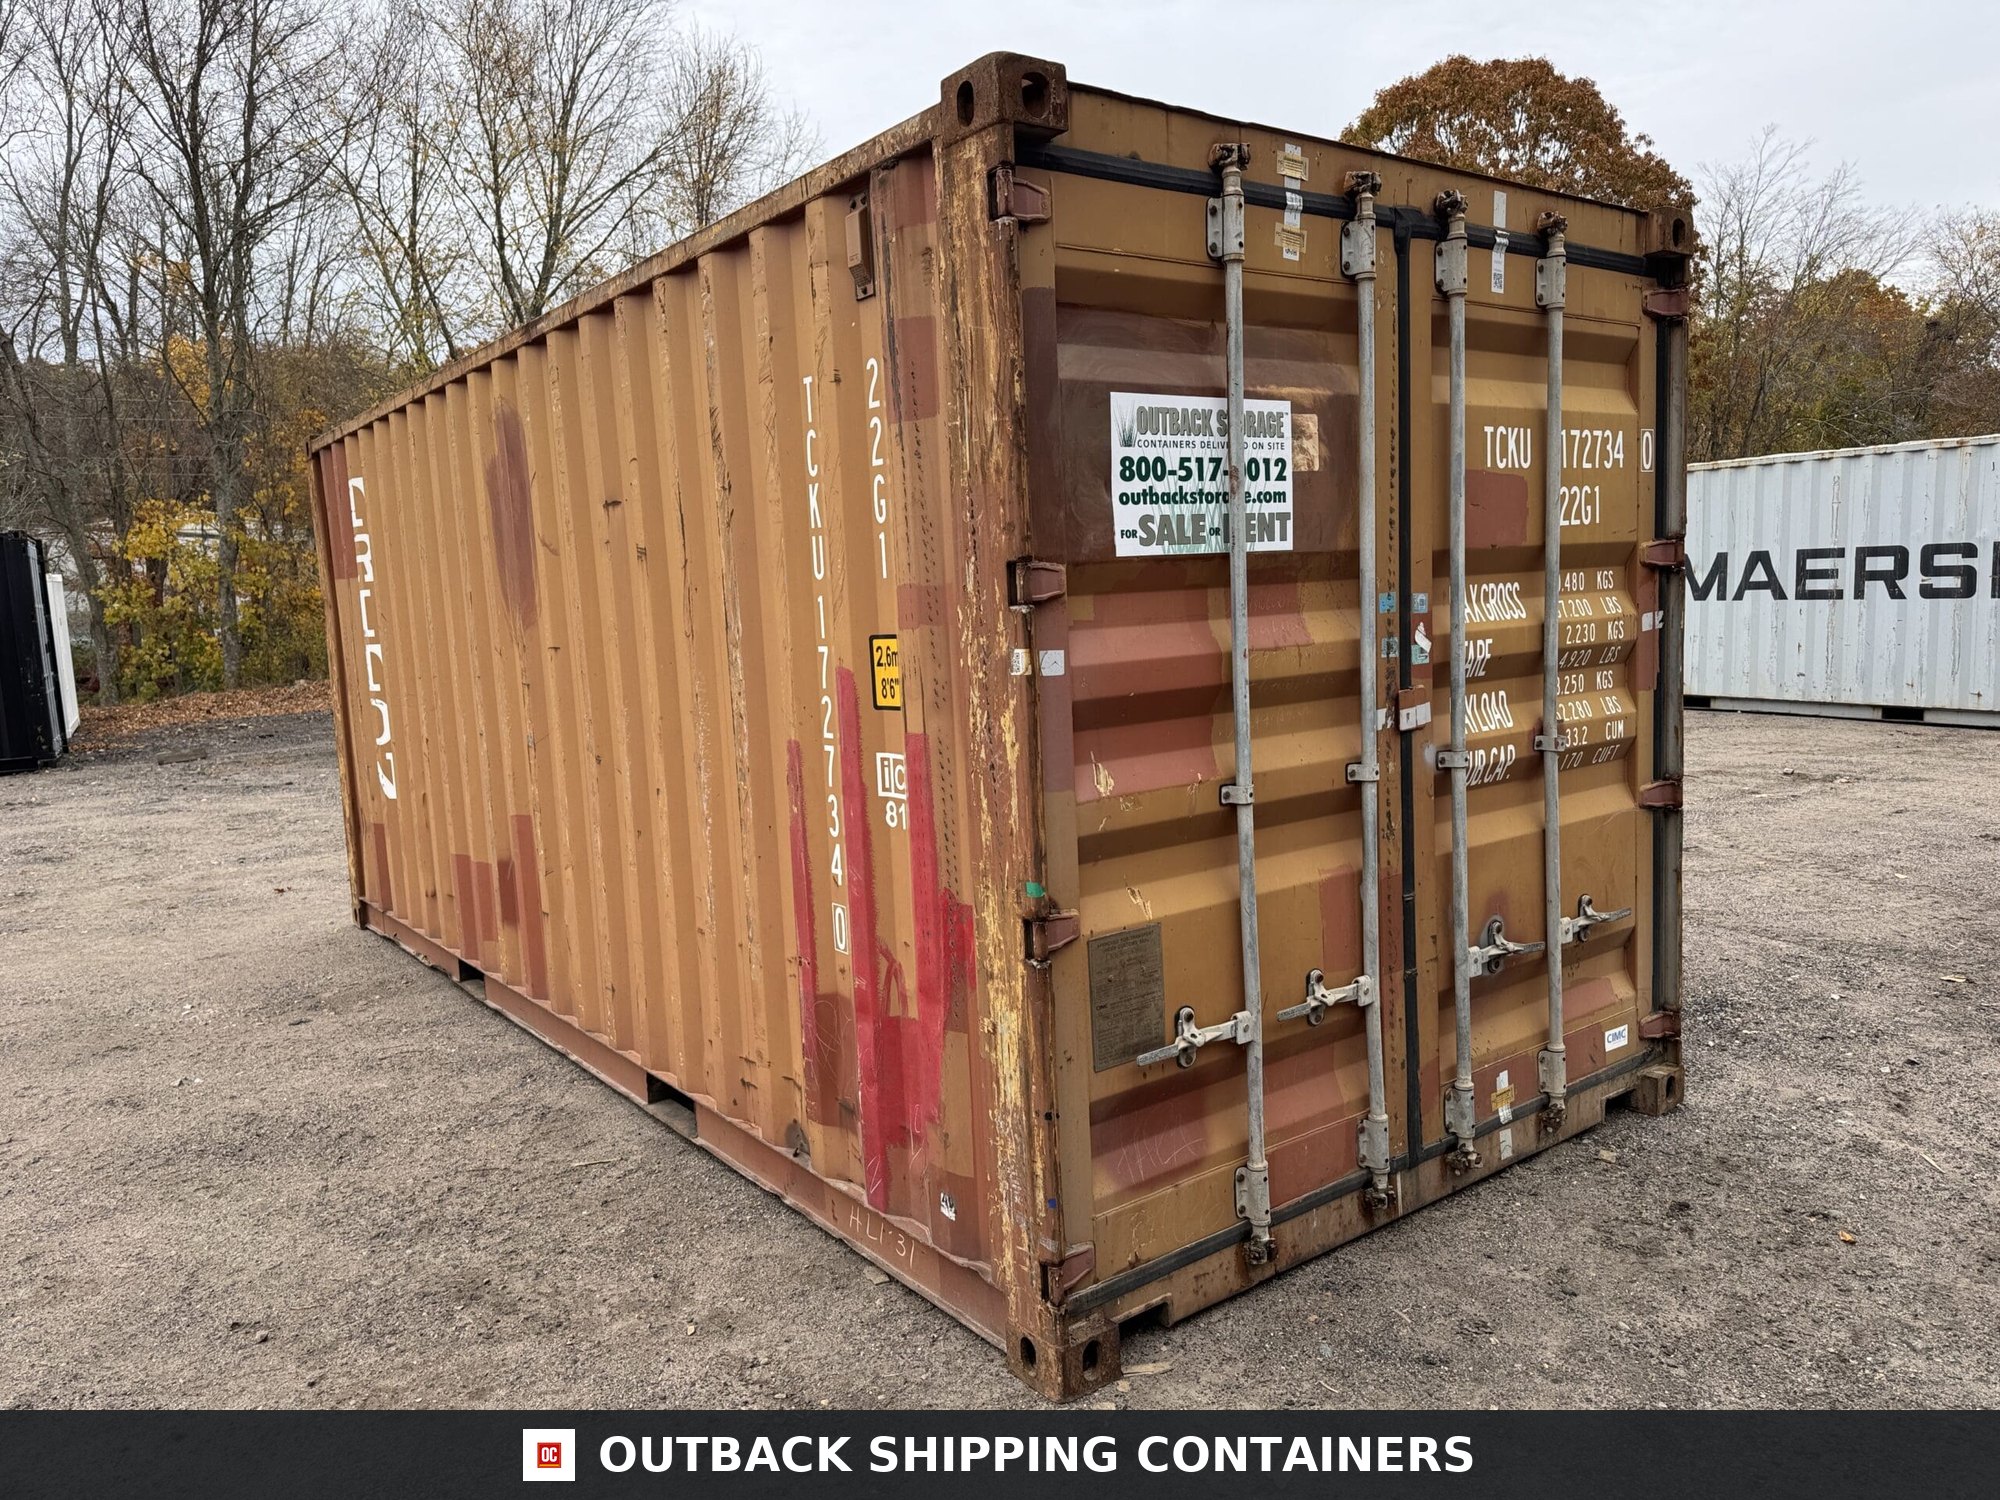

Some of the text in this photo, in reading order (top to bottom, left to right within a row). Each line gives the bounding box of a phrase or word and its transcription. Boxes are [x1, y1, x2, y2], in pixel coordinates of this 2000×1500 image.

[1136, 406, 1284, 438] OUTBACK SRAGE
[1137, 439, 1196, 450] CONTAINERS
[1252, 442, 1264, 450] ON
[1268, 442, 1285, 451] SITE
[1484, 425, 1652, 471] TCKU 172734 0
[866, 357, 888, 579] 22G1
[1119, 456, 1287, 482] 800-517-012
[1560, 485, 1600, 526] 22G1
[1120, 529, 1137, 539] FOR
[1138, 513, 1206, 547] SALE
[1209, 527, 1221, 537] OR
[1558, 570, 1614, 592] .480 KGS
[1685, 541, 2000, 601] MAERS
[1600, 596, 1622, 615] LBS
[1566, 620, 1624, 645] 2.230 KGS
[1559, 645, 1622, 669] 4.920 LBS
[1596, 670, 1614, 690] KGS
[1600, 695, 1622, 715] LBS
[1565, 725, 1588, 747] 33.2
[1607, 1028, 1626, 1044] CIMC
